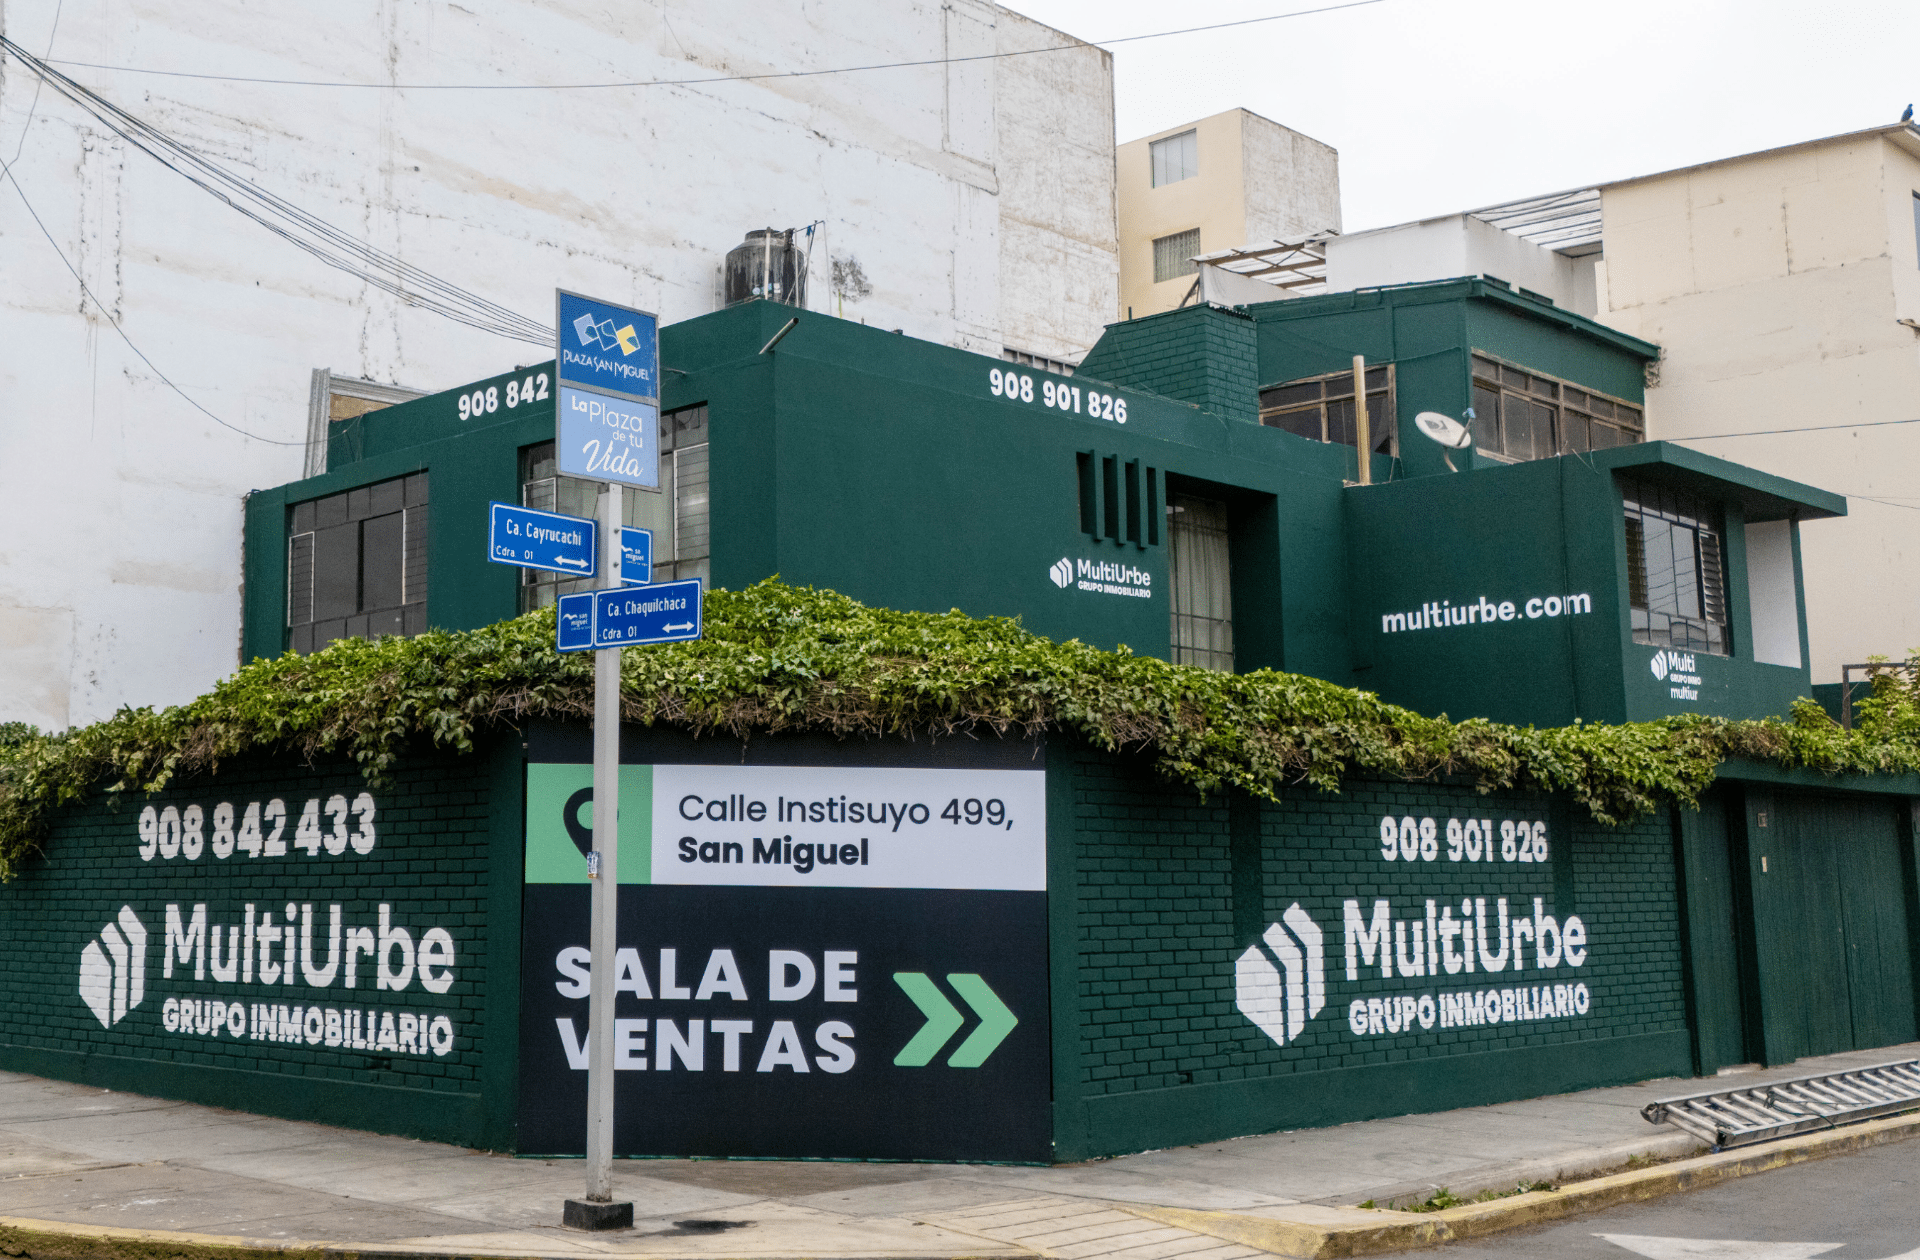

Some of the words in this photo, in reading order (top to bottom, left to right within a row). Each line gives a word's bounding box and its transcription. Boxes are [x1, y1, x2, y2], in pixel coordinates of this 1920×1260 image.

[563, 349, 593, 367] PLAZA
[614, 362, 650, 381] MIGUEL
[458, 386, 498, 421] 908
[506, 373, 549, 408] 842
[572, 395, 588, 413] La
[589, 401, 643, 433] Plaza
[990, 369, 1034, 403] 908
[1043, 381, 1081, 414] 901
[1088, 391, 1128, 424] 826
[582, 439, 644, 478] Vida
[612, 430, 627, 442] de
[629, 432, 643, 448] tu
[506, 518, 522, 537] Ca.
[526, 522, 581, 546] Cayrucachi
[1077, 558, 1151, 587] MultiUrbe
[1077, 580, 1103, 593] GRUPO
[1103, 584, 1151, 599] INMOBILIARIO
[608, 602, 622, 618] Ca.
[1383, 593, 1592, 633] multiurbe.com
[1667, 651, 1695, 672] Multi
[138, 805, 204, 862] 908
[212, 798, 287, 860] 842
[294, 792, 377, 857] 433
[679, 794, 767, 822] Calle
[778, 794, 930, 833] Instisuyo
[940, 798, 1014, 831] 499,
[678, 836, 744, 864] San
[752, 834, 869, 874] Miguel
[1380, 815, 1438, 862] 908
[1446, 818, 1493, 862] 901
[1500, 820, 1548, 863] 826
[163, 902, 455, 994] MultiUrbe
[1343, 898, 1588, 981] MultiUrbe
[555, 946, 748, 1000] SALA
[769, 949, 858, 1002] DE
[162, 998, 246, 1039] GRUPO
[250, 1003, 453, 1057] INMOBILIARIO
[1349, 994, 1436, 1036] GRUPO
[1438, 983, 1590, 1029] INMOBILIARIO
[555, 1017, 856, 1074] VENTAS
